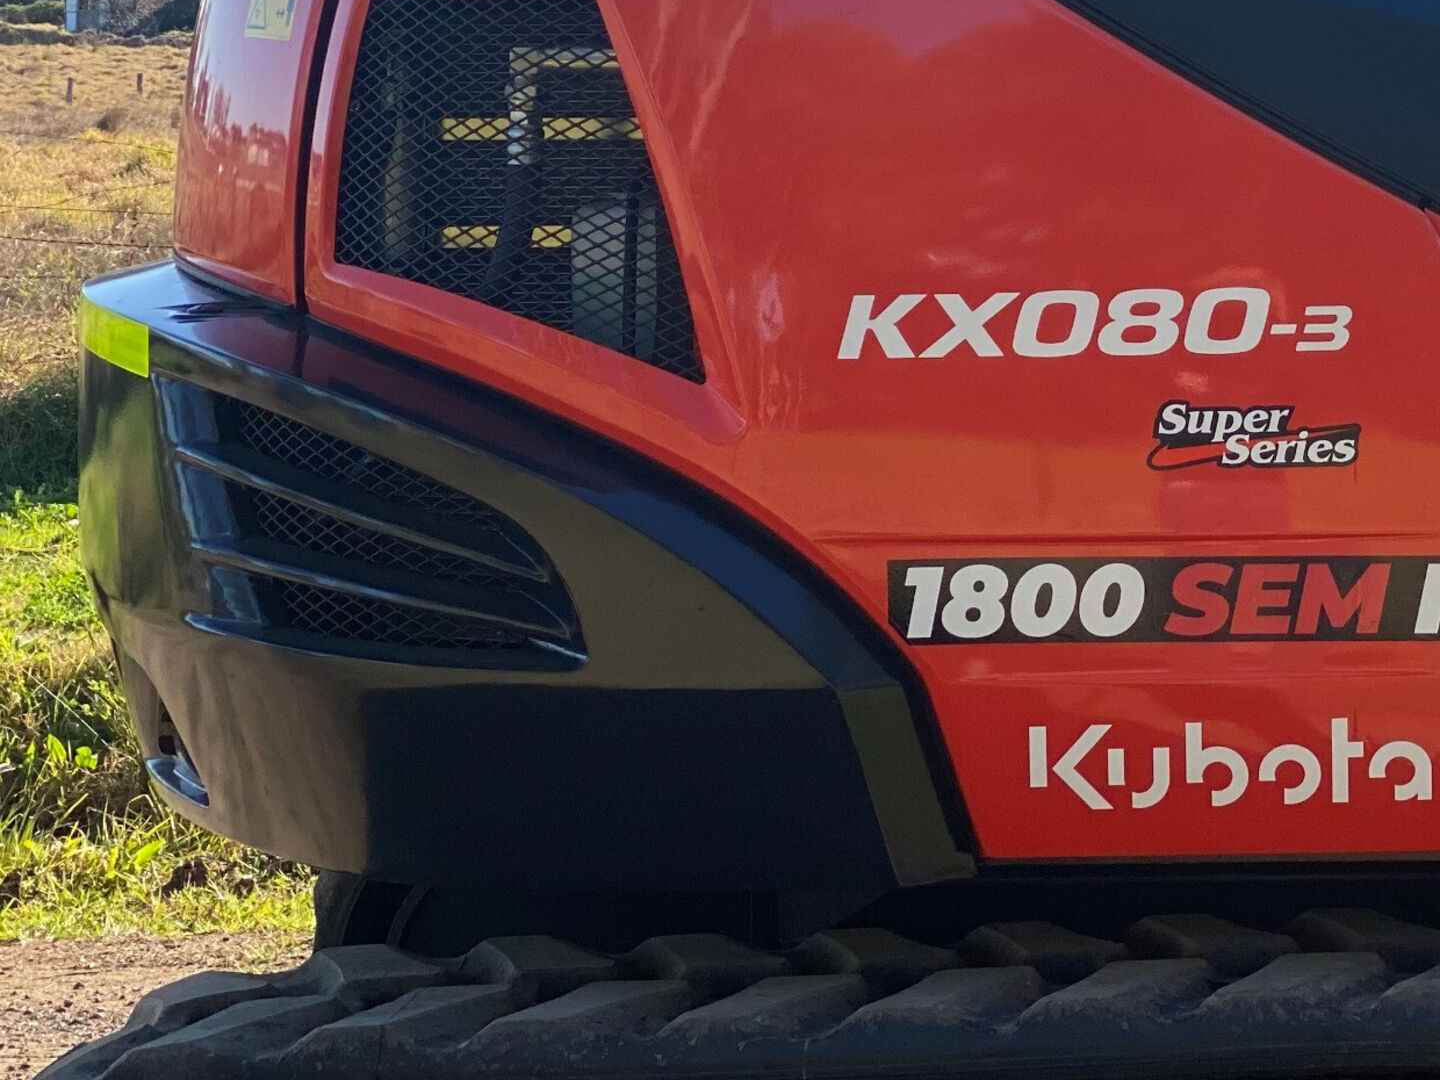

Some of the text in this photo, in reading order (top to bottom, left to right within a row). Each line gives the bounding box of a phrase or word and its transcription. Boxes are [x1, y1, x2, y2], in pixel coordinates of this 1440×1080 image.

[838, 287, 1353, 360] KX080-3
[1158, 403, 1290, 442] Super
[1221, 431, 1356, 464] Series
[904, 563, 1145, 639] 1800
[1166, 563, 1390, 636] SEM
[1028, 717, 1433, 810] Kubota
